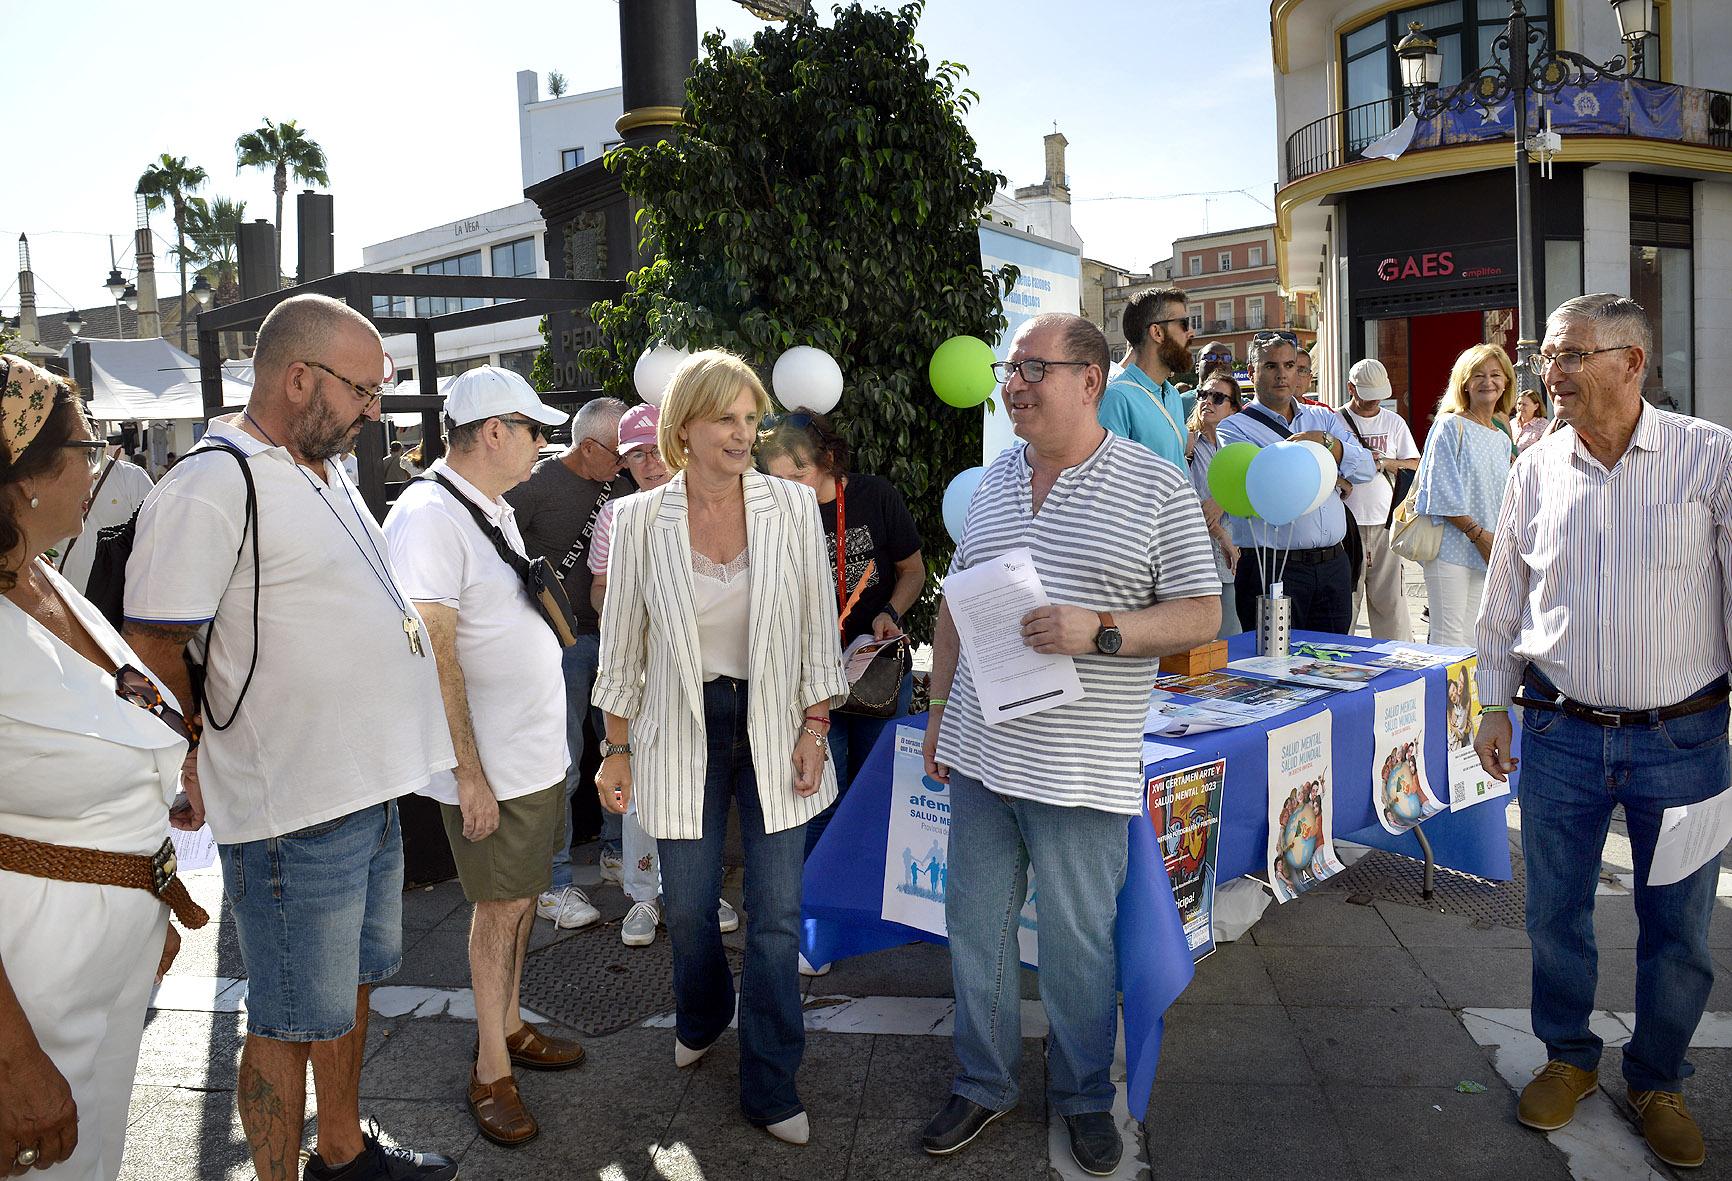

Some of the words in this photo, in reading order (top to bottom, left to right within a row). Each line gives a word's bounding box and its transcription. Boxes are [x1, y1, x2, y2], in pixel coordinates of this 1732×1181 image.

[464, 220, 480, 233] VEGA
[1377, 251, 1455, 281] GAES
[1281, 740, 1300, 759] SALUD
[1300, 731, 1322, 751] MENTAL
[1281, 755, 1298, 773] SALUD
[1299, 744, 1322, 765] MUNDIAL
[1165, 772, 1199, 789] CERTAMEN
[1198, 767, 1215, 780] ARTE
[1215, 765, 1221, 775] Y
[1154, 794, 1174, 809] SALUD
[1174, 787, 1199, 802] MENTAL
[1200, 781, 1217, 794] 2023
[910, 809, 938, 823] SALUD
[921, 822, 943, 835] Provincia
